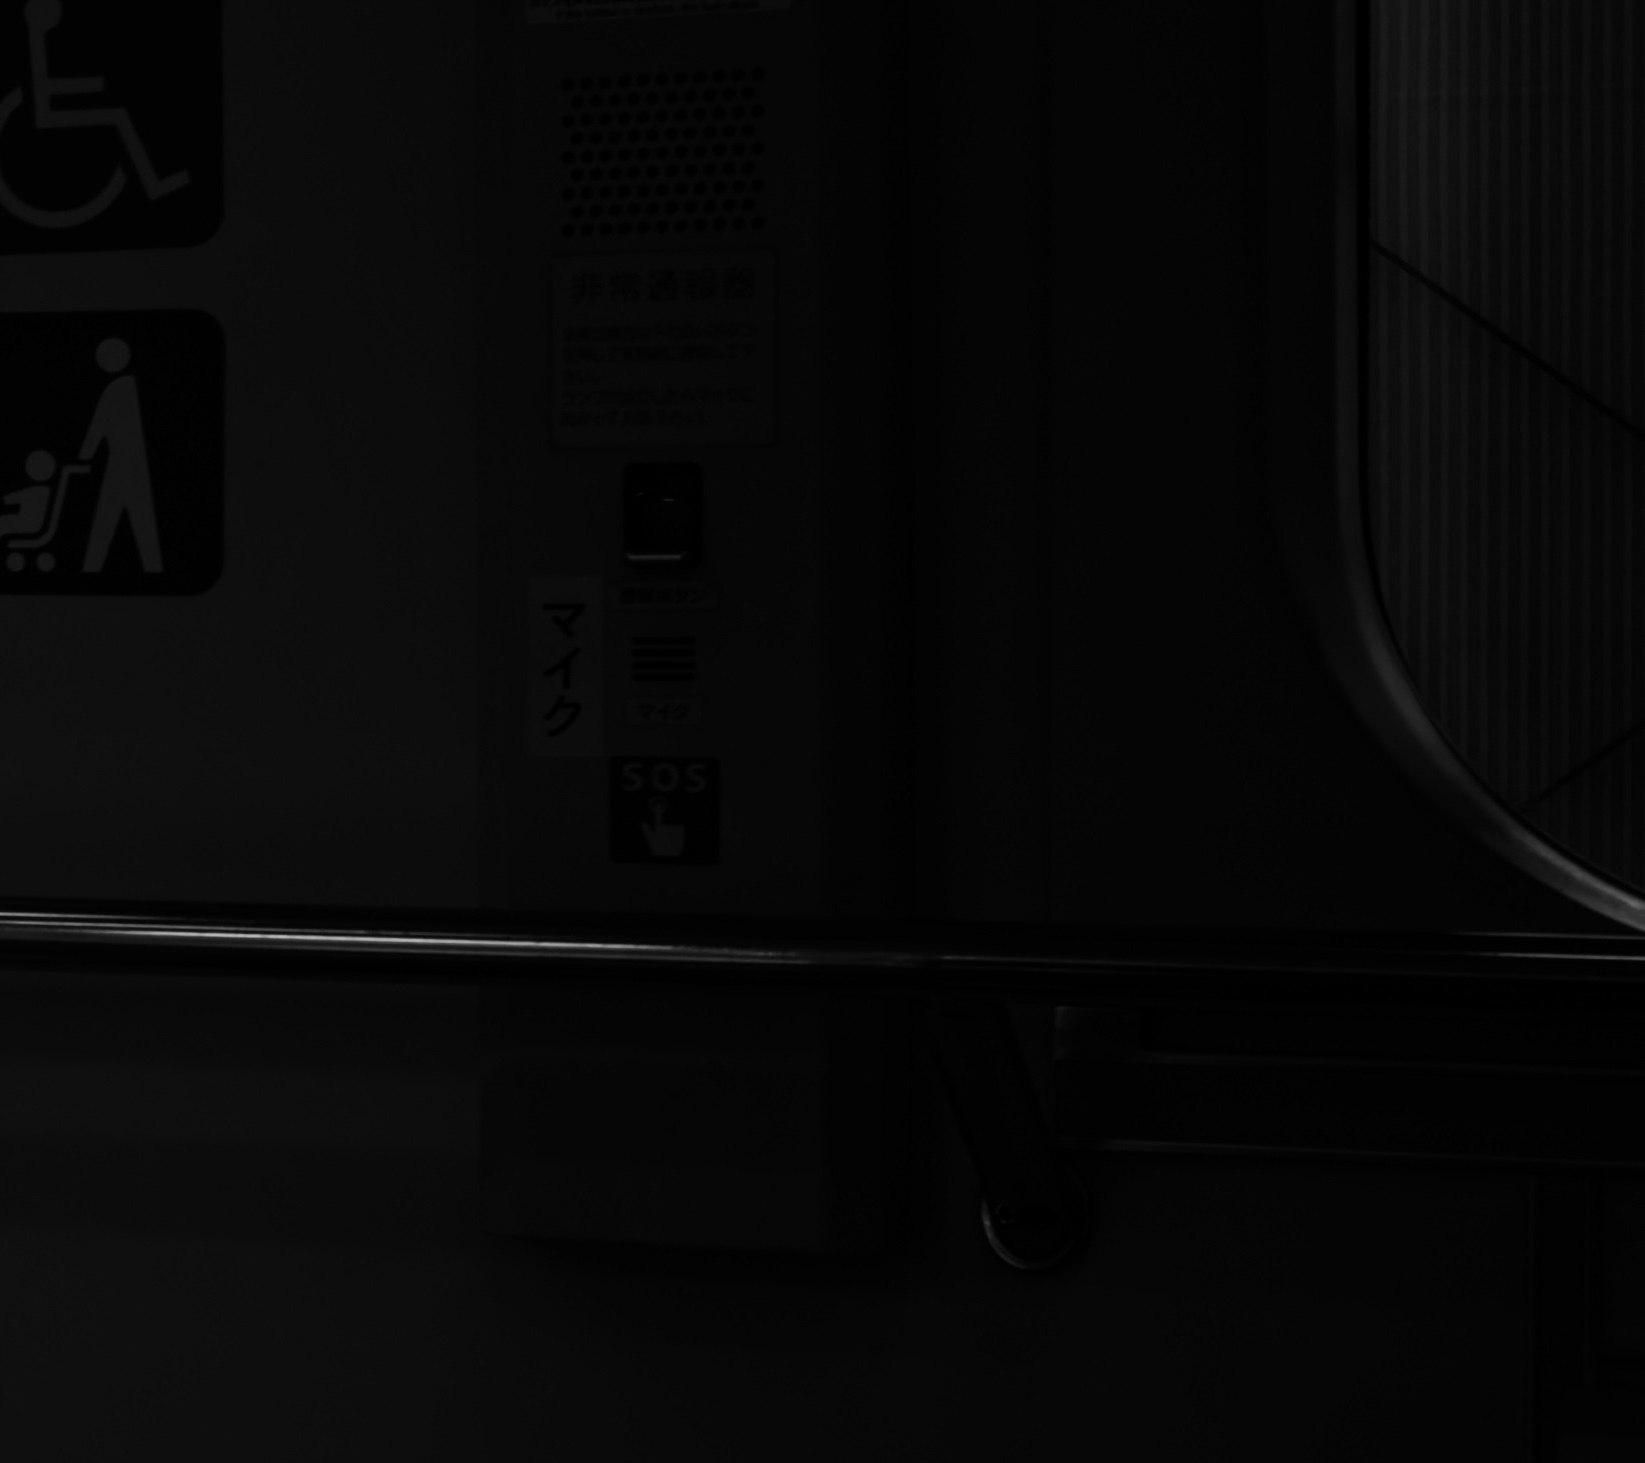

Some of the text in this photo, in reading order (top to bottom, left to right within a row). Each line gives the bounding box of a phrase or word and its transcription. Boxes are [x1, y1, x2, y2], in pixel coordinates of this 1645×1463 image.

[571, 267, 755, 304] 非常通報器
[542, 603, 586, 737] マイク
[637, 703, 690, 720] マイク
[622, 763, 707, 792] SOS
